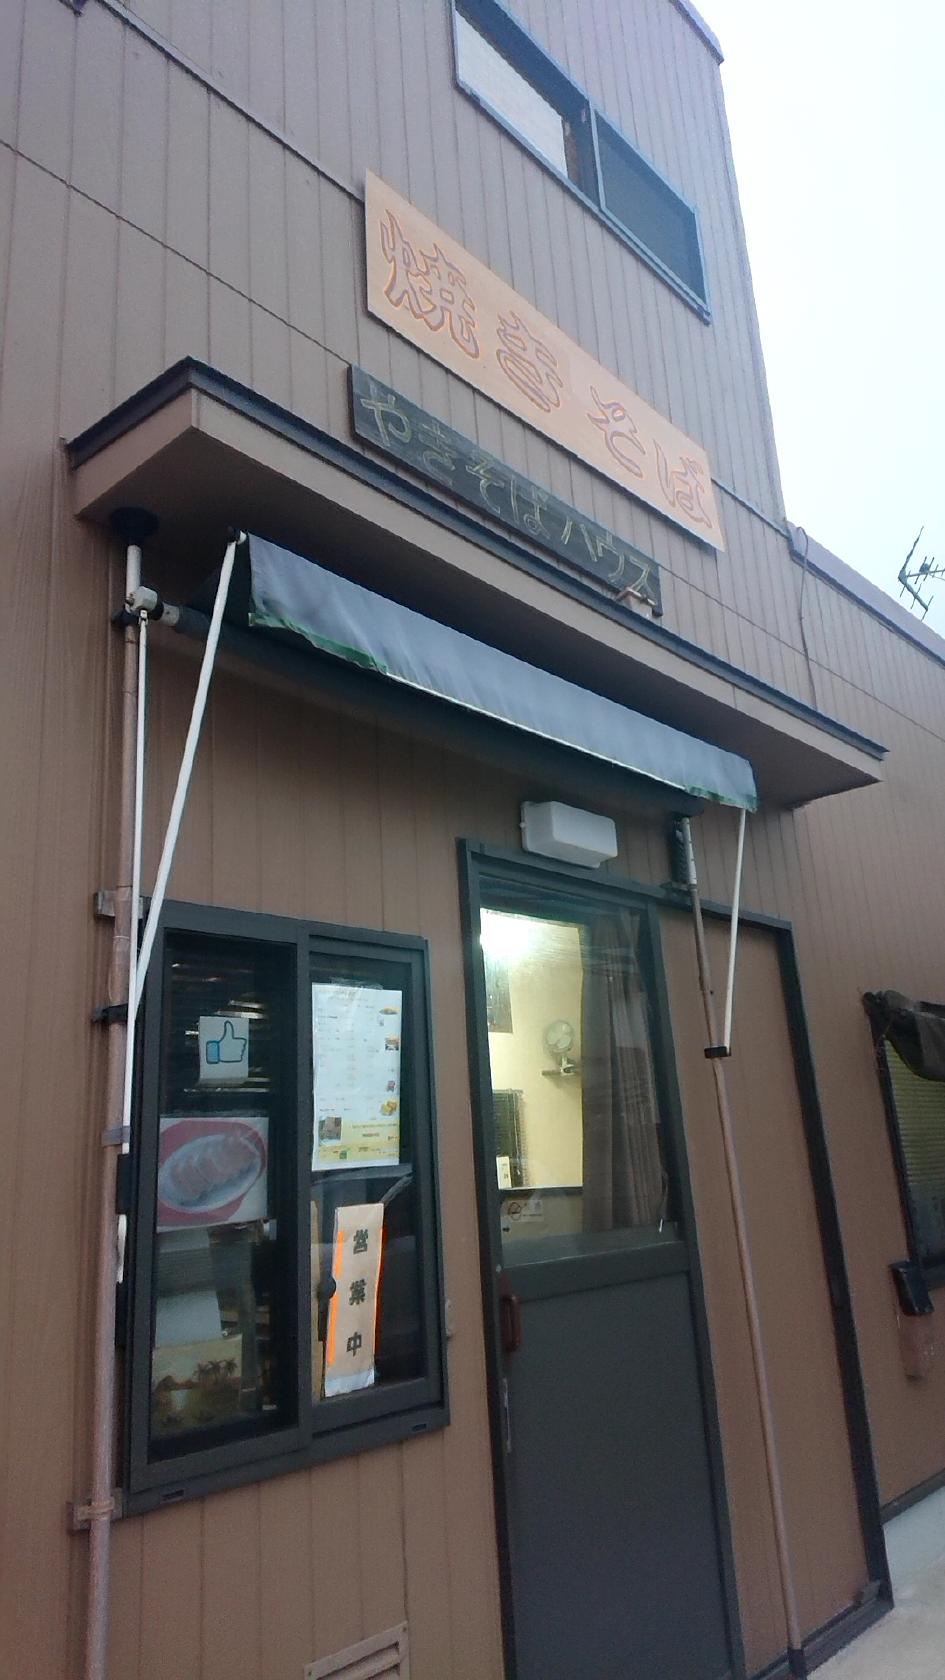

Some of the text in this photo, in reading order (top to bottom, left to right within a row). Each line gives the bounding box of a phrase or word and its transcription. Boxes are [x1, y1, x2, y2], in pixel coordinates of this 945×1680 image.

[380, 208, 713, 529] 焼きそば
[360, 380, 656, 596] やきそばハウス
[346, 1227, 369, 1358] 営業中
